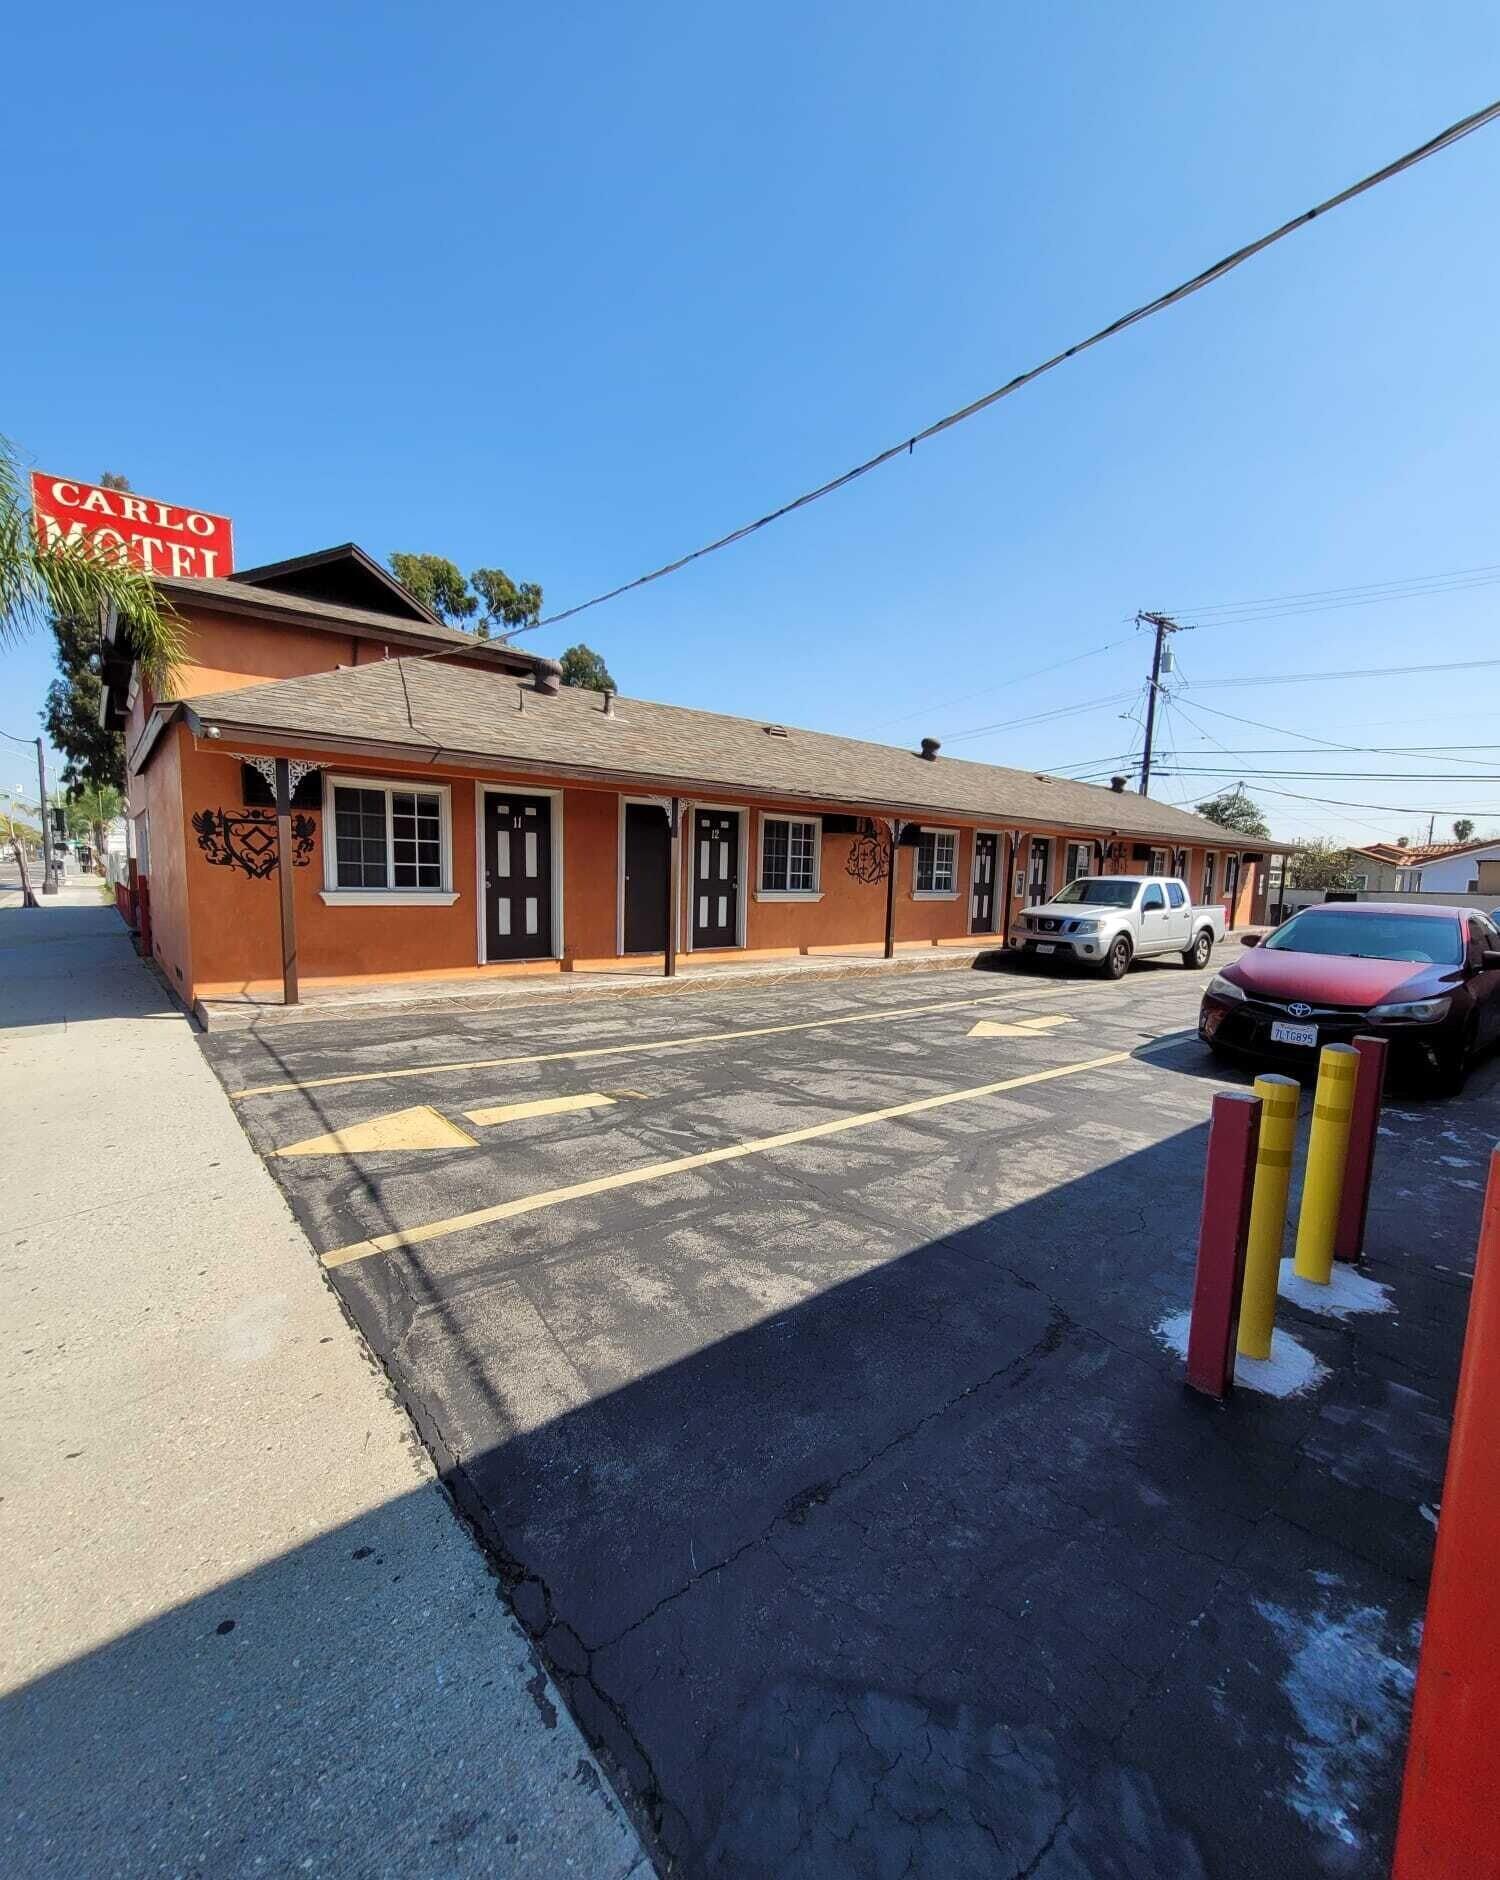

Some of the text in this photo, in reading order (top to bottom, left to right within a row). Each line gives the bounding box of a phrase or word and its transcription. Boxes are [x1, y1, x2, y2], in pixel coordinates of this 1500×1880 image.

[52, 482, 215, 536] CARLO
[513, 816, 521, 829] 11
[712, 829, 720, 839] 12
[1275, 1028, 1313, 1044] 7LTG895
